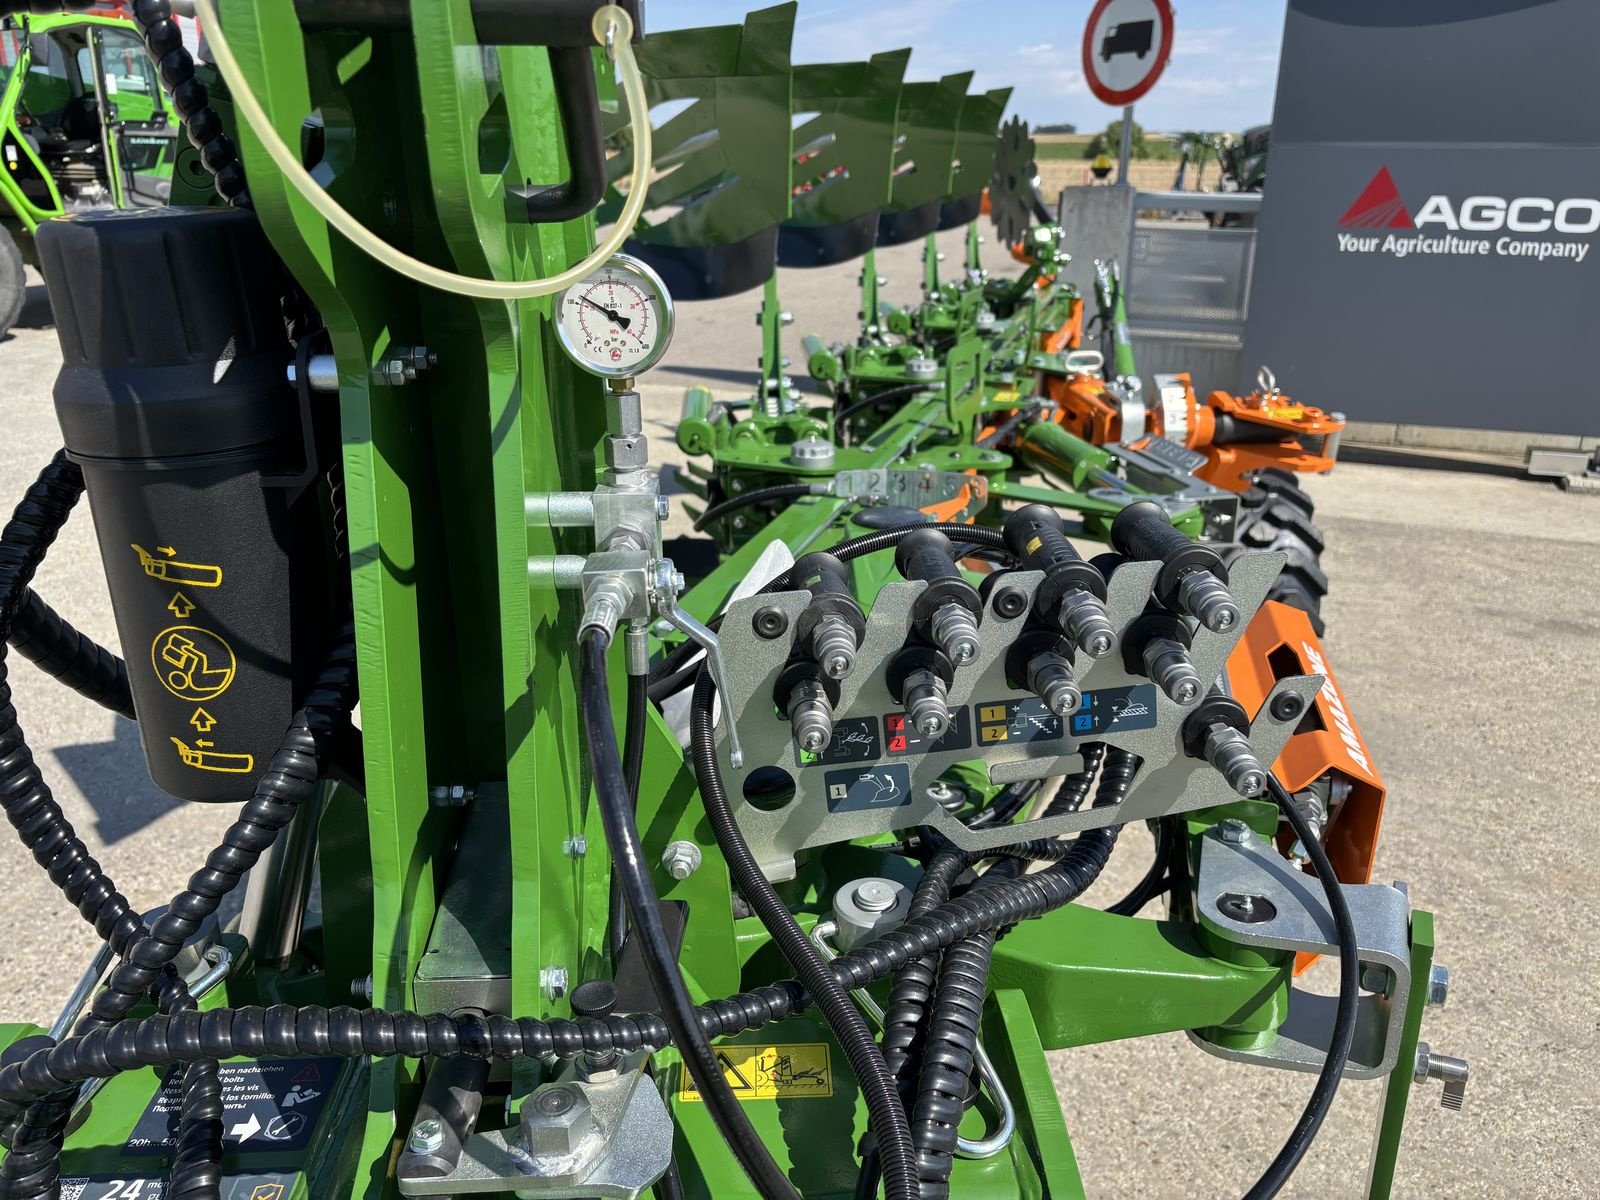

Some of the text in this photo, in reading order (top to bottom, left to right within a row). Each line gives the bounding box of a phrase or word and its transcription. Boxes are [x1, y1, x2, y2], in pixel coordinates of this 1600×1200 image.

[1414, 195, 1600, 234] AGCO
[1337, 233, 1590, 262] Your Agriculture Company
[238, 1066, 285, 1075] nachziehen
[240, 1093, 276, 1101] tornillos
[98, 1179, 146, 1200] 24
